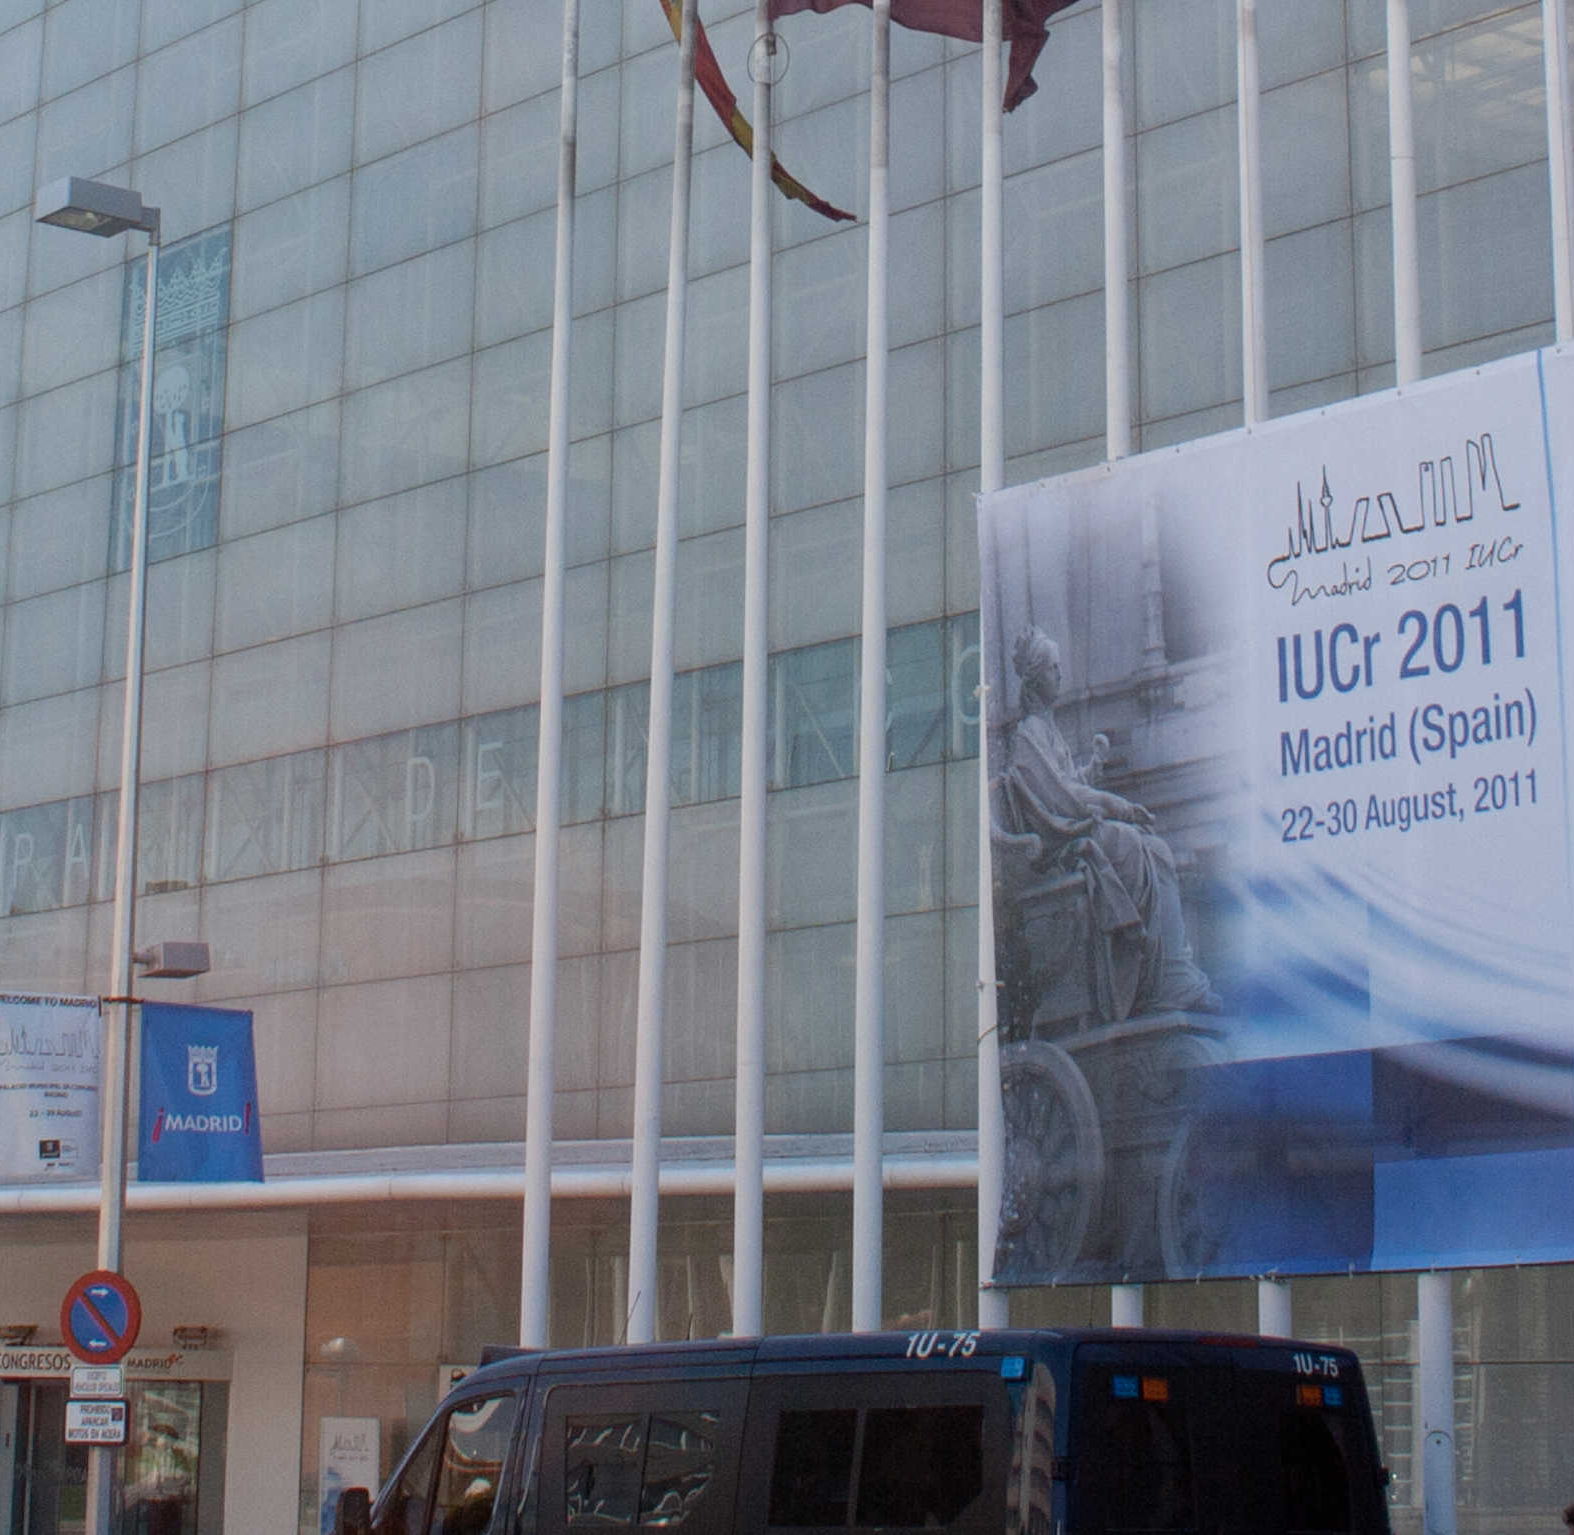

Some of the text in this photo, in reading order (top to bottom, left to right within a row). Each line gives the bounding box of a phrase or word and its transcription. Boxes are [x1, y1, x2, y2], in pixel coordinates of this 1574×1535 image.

[1287, 536, 1524, 606] Madrid 2011 IUCr
[1276, 588, 1526, 703] IUCr 2011
[1280, 688, 1537, 777] Madrid (Spain)
[1281, 768, 1538, 843] 22-30 August, 2011
[44, 996, 58, 1007] TO
[60, 997, 98, 1008] MADRID
[905, 1330, 981, 1359] 1U-75
[1292, 1352, 1339, 1379] 1U-75
